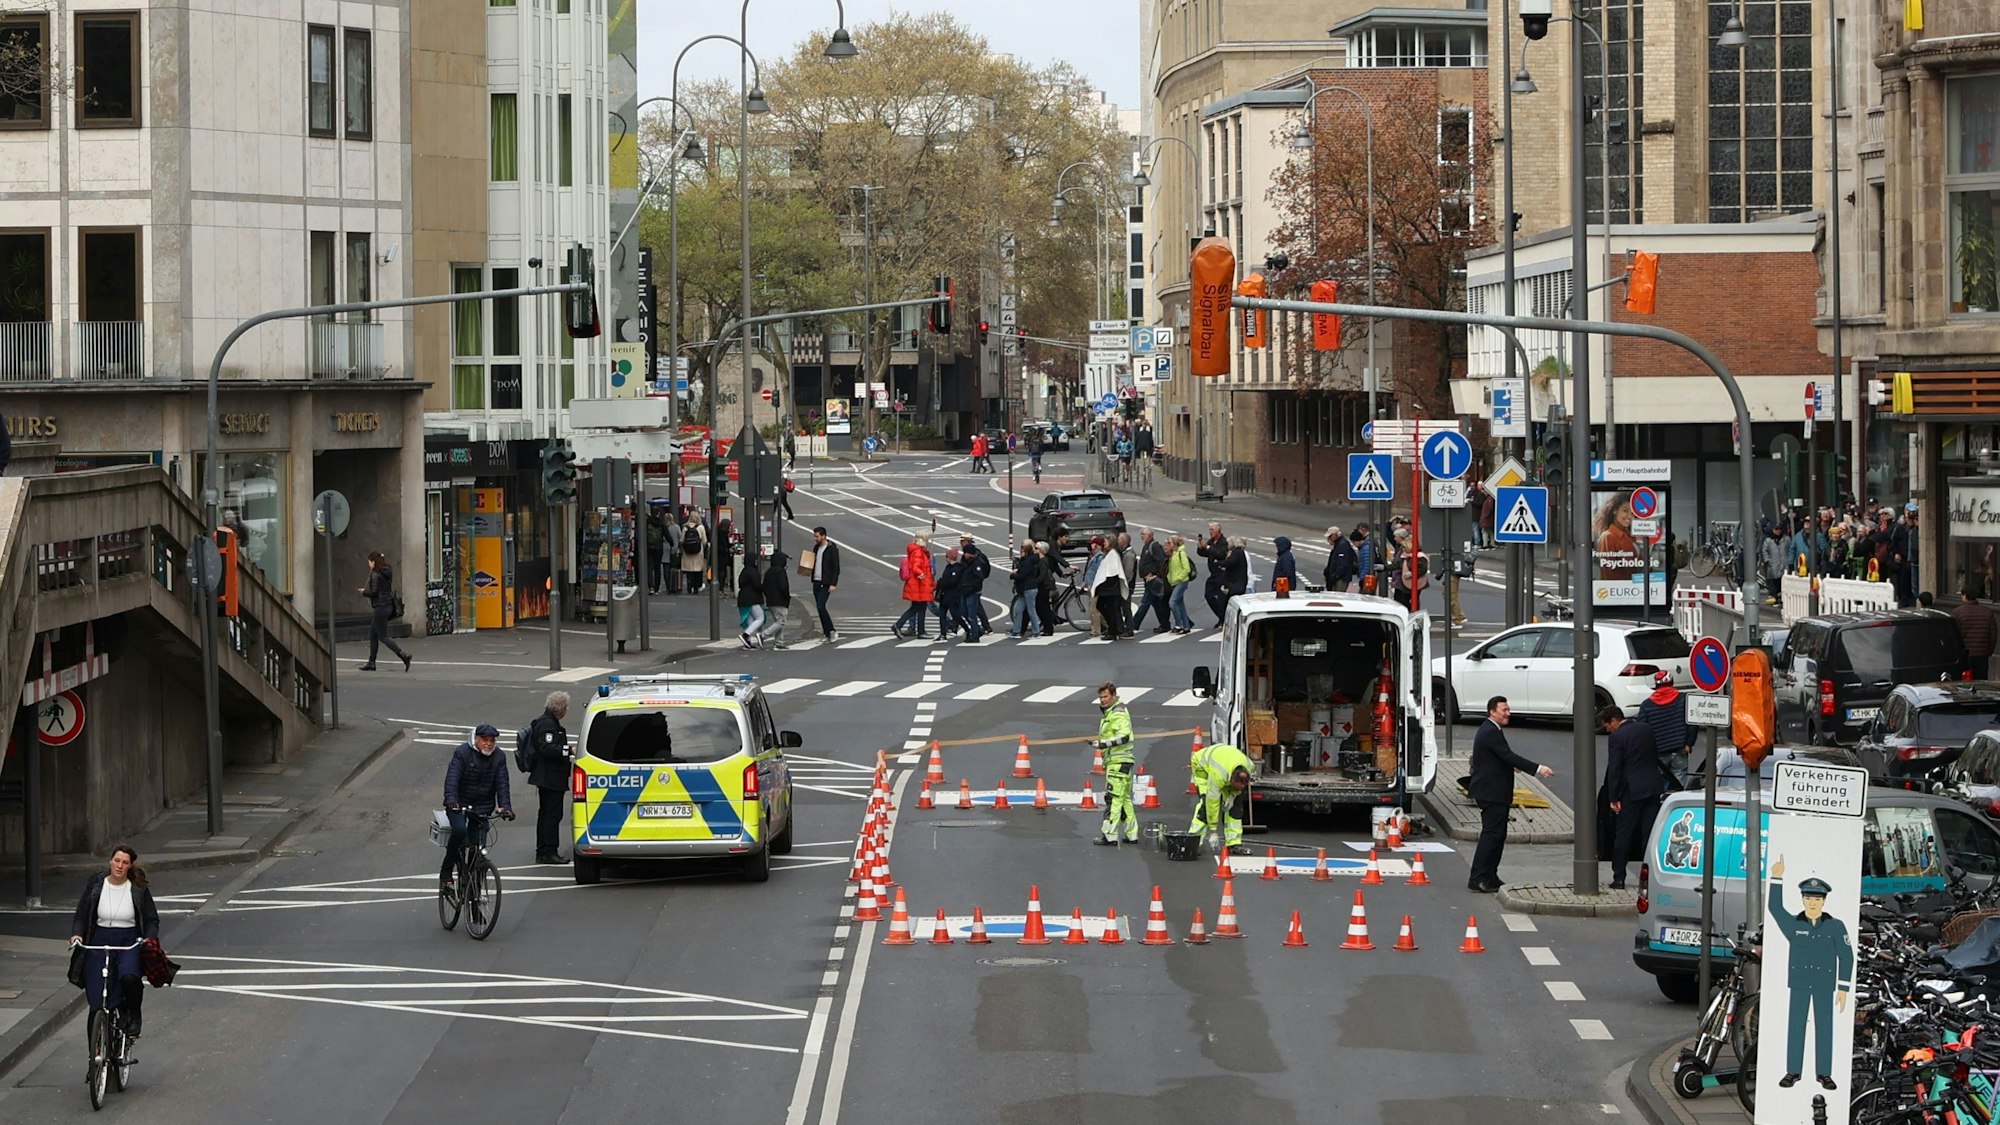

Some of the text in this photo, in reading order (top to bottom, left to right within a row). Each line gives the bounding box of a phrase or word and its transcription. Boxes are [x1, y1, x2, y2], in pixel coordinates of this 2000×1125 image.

[1200, 284, 1217, 359] Signalbau
[1141, 364, 1150, 376] P
[1626, 467, 1668, 475] Hauptbahnhof
[1600, 557, 1659, 569] Psycholoie
[1609, 587, 1658, 597] EURO-H
[1707, 701, 1719, 709] dem
[587, 775, 644, 788] POLIZEI
[1784, 768, 1856, 782] Verkehrs-
[1791, 781, 1848, 797] führung
[1786, 795, 1850, 809] geändert
[1670, 929, 1676, 940] K
[1680, 931, 1691, 942] OR
